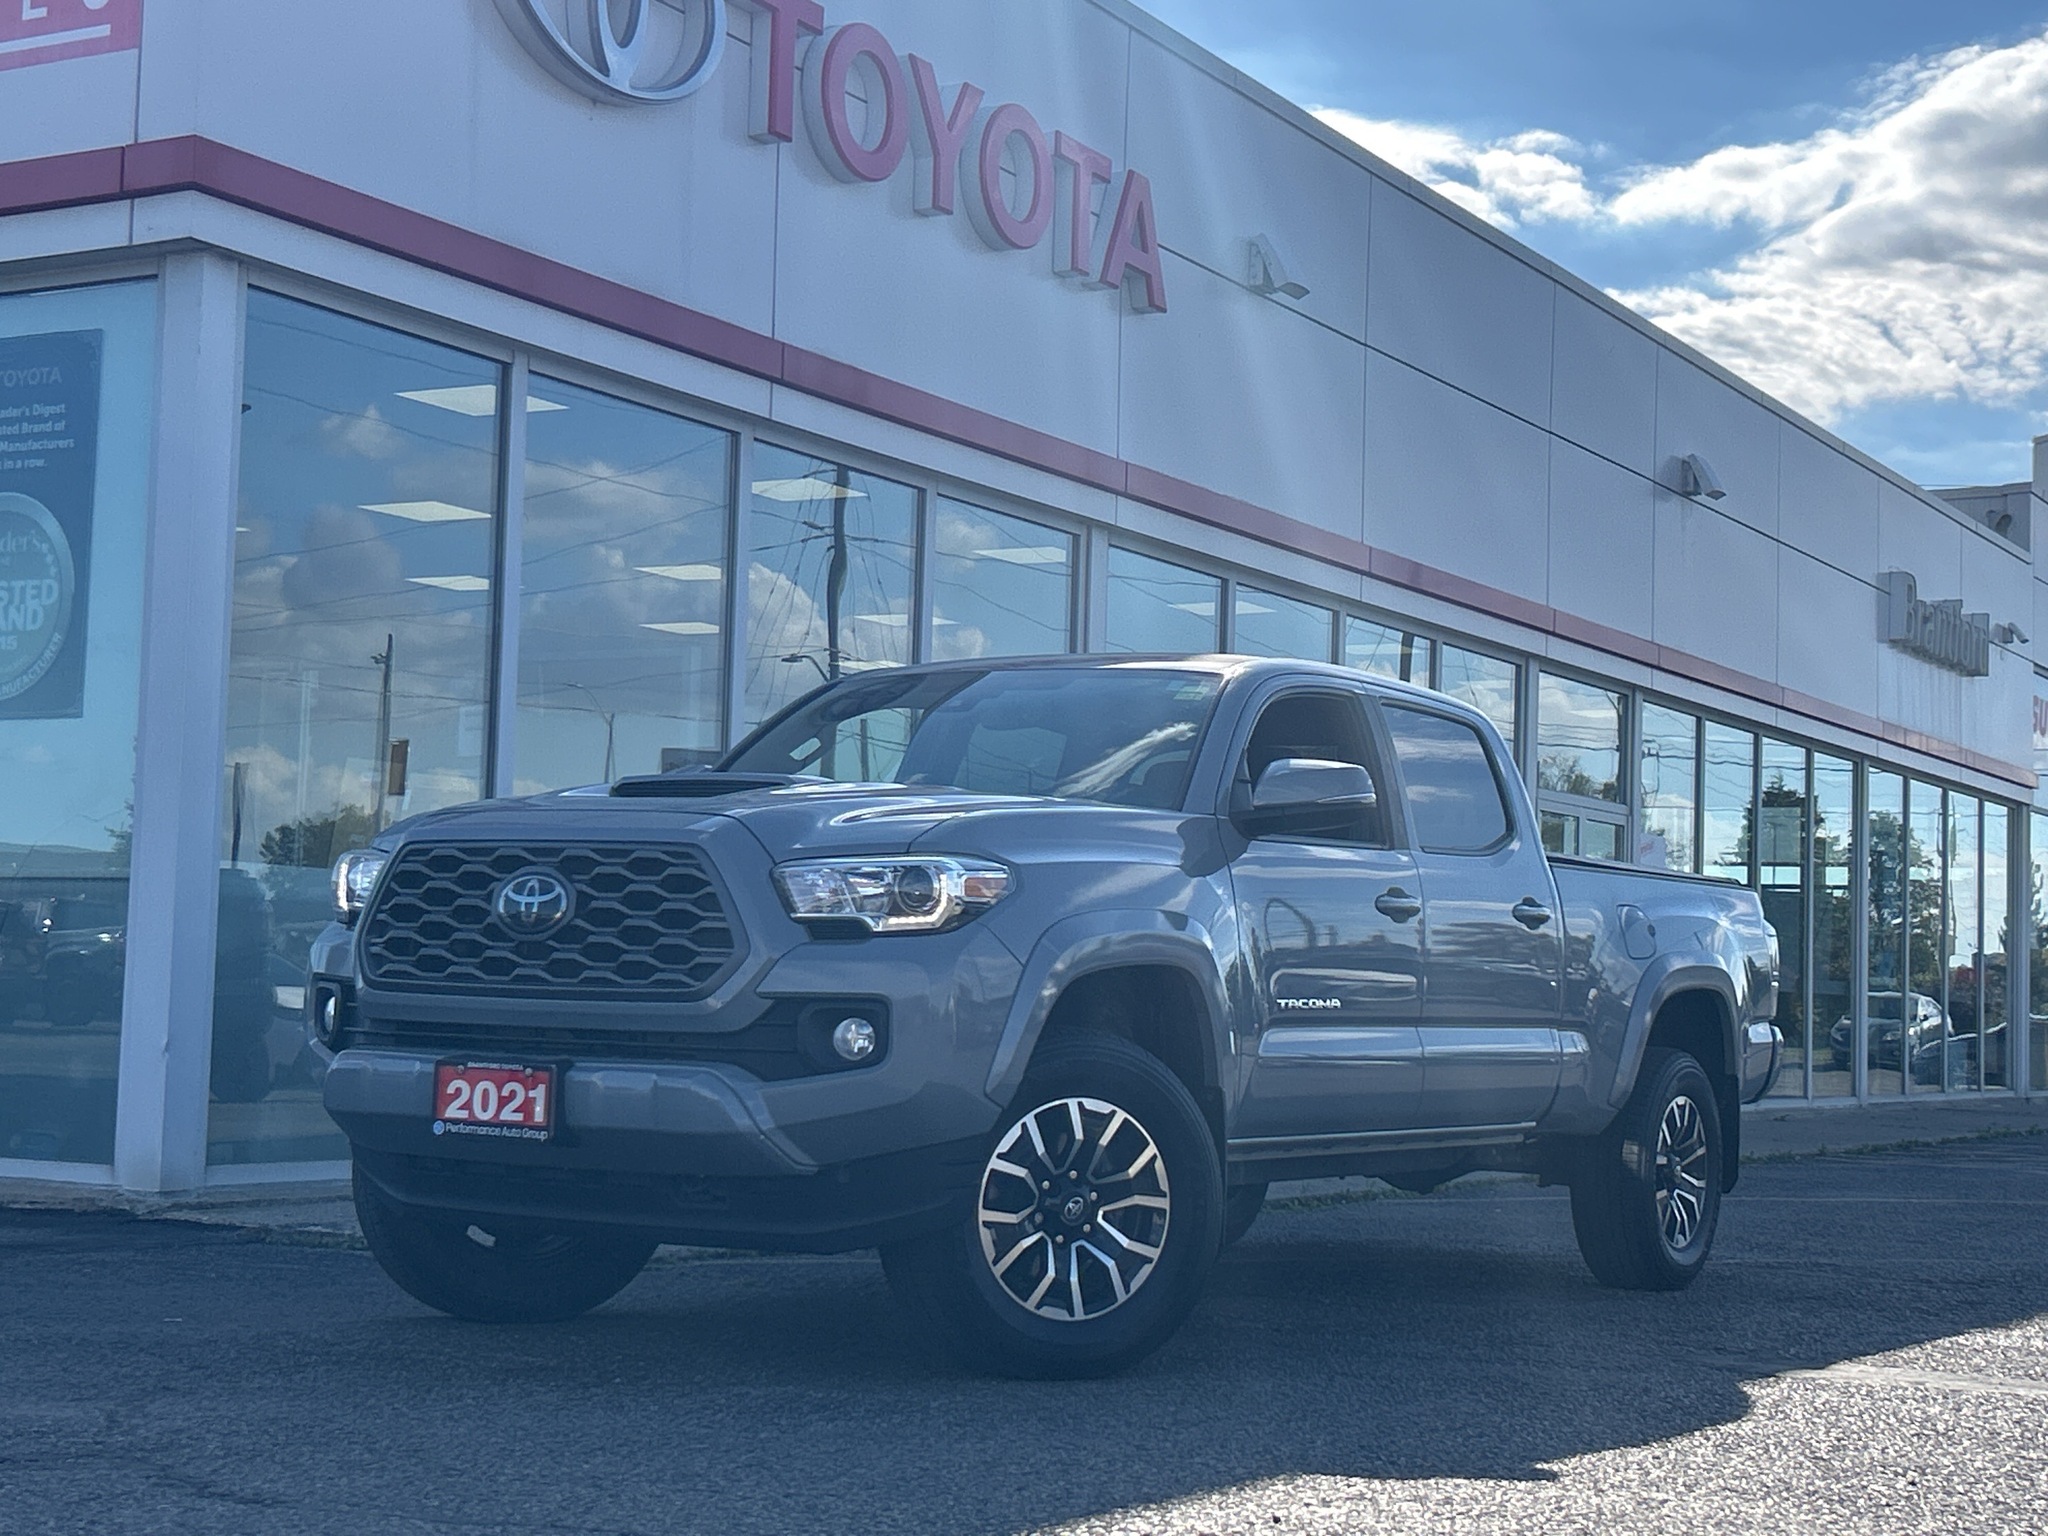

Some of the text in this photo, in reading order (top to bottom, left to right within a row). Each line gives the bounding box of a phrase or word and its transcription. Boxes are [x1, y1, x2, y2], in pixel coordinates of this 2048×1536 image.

[750, 0, 1167, 313] TOYOTA
[33, 403, 65, 417] Digest
[22, 420, 52, 434] Brand
[54, 420, 66, 431] of
[1276, 998, 1341, 1009] TACOMA
[444, 1079, 546, 1122] 2021
[445, 1121, 548, 1142] Performance Auto Group
